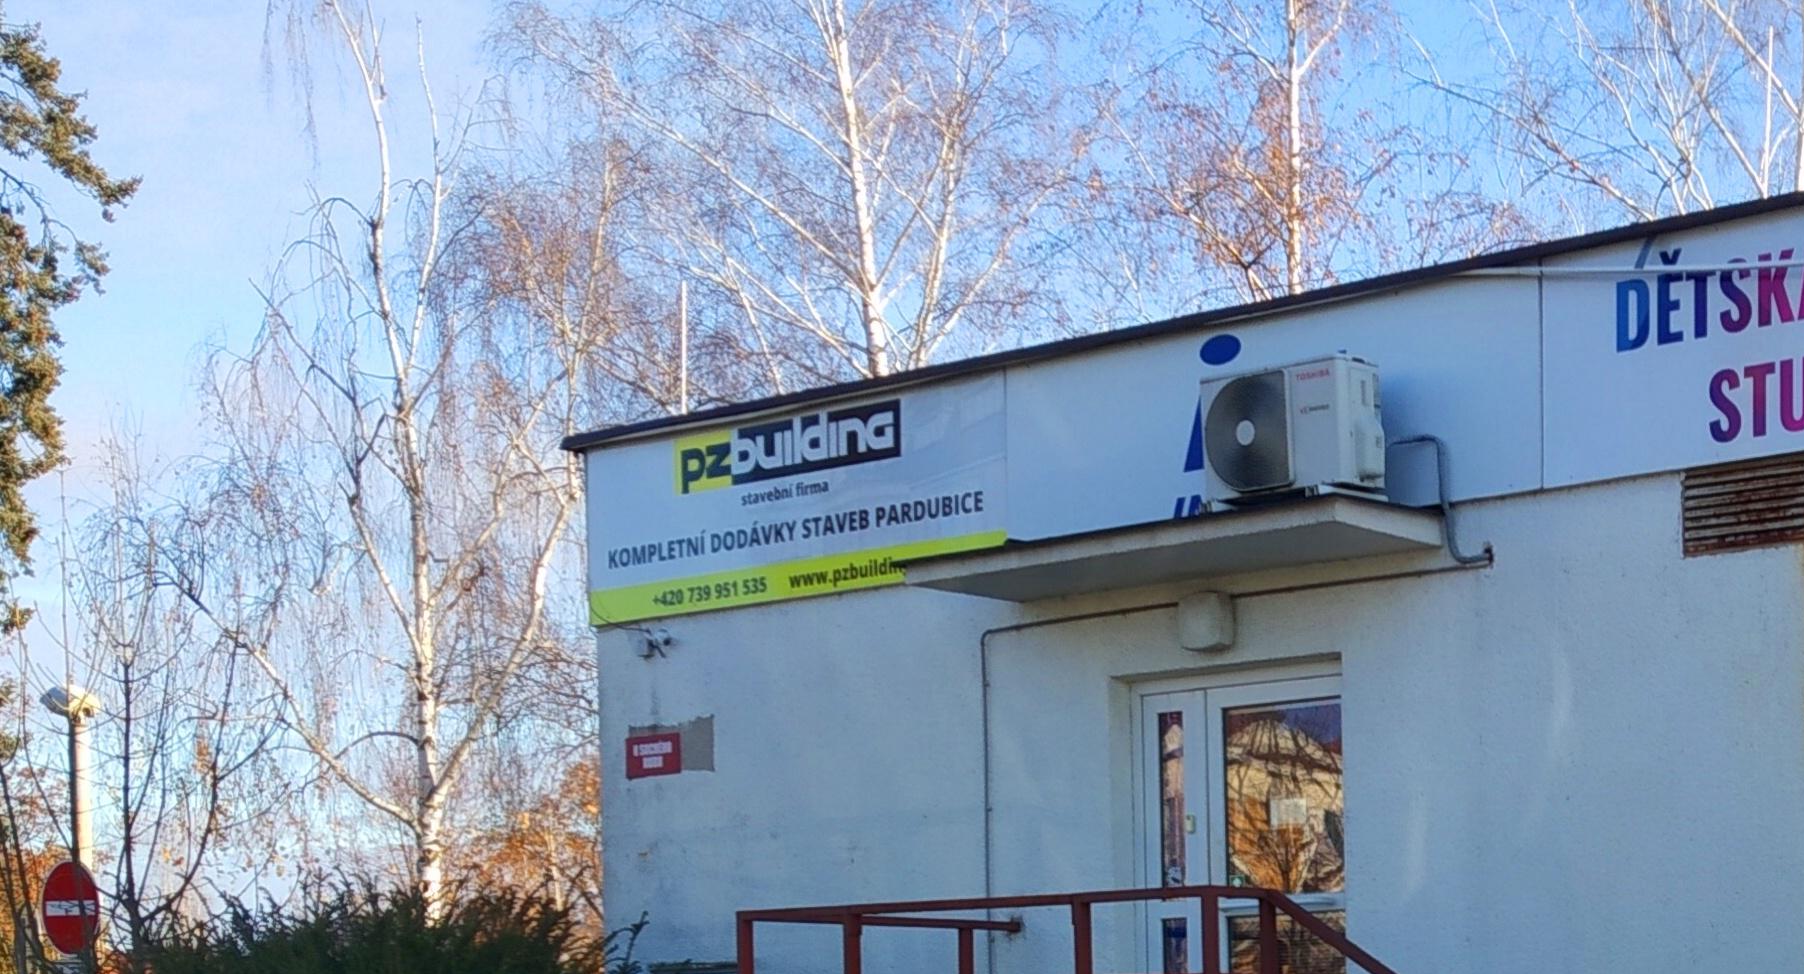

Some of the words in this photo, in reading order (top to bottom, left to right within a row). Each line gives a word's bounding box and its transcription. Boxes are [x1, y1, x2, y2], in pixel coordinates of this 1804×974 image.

[681, 410, 895, 494] pzbuilding
[741, 483, 793, 506] stavební
[795, 479, 829, 500] firma
[607, 529, 705, 569] KOMPLETNÍ
[710, 520, 796, 554] DODÁVKY
[802, 508, 869, 540] STAVEB
[876, 491, 984, 529] PARDUBICE
[652, 588, 684, 607] +420
[687, 585, 713, 604] 739
[715, 581, 739, 600] 951
[742, 576, 767, 596] 535
[788, 556, 906, 589] www.pzbuildi
